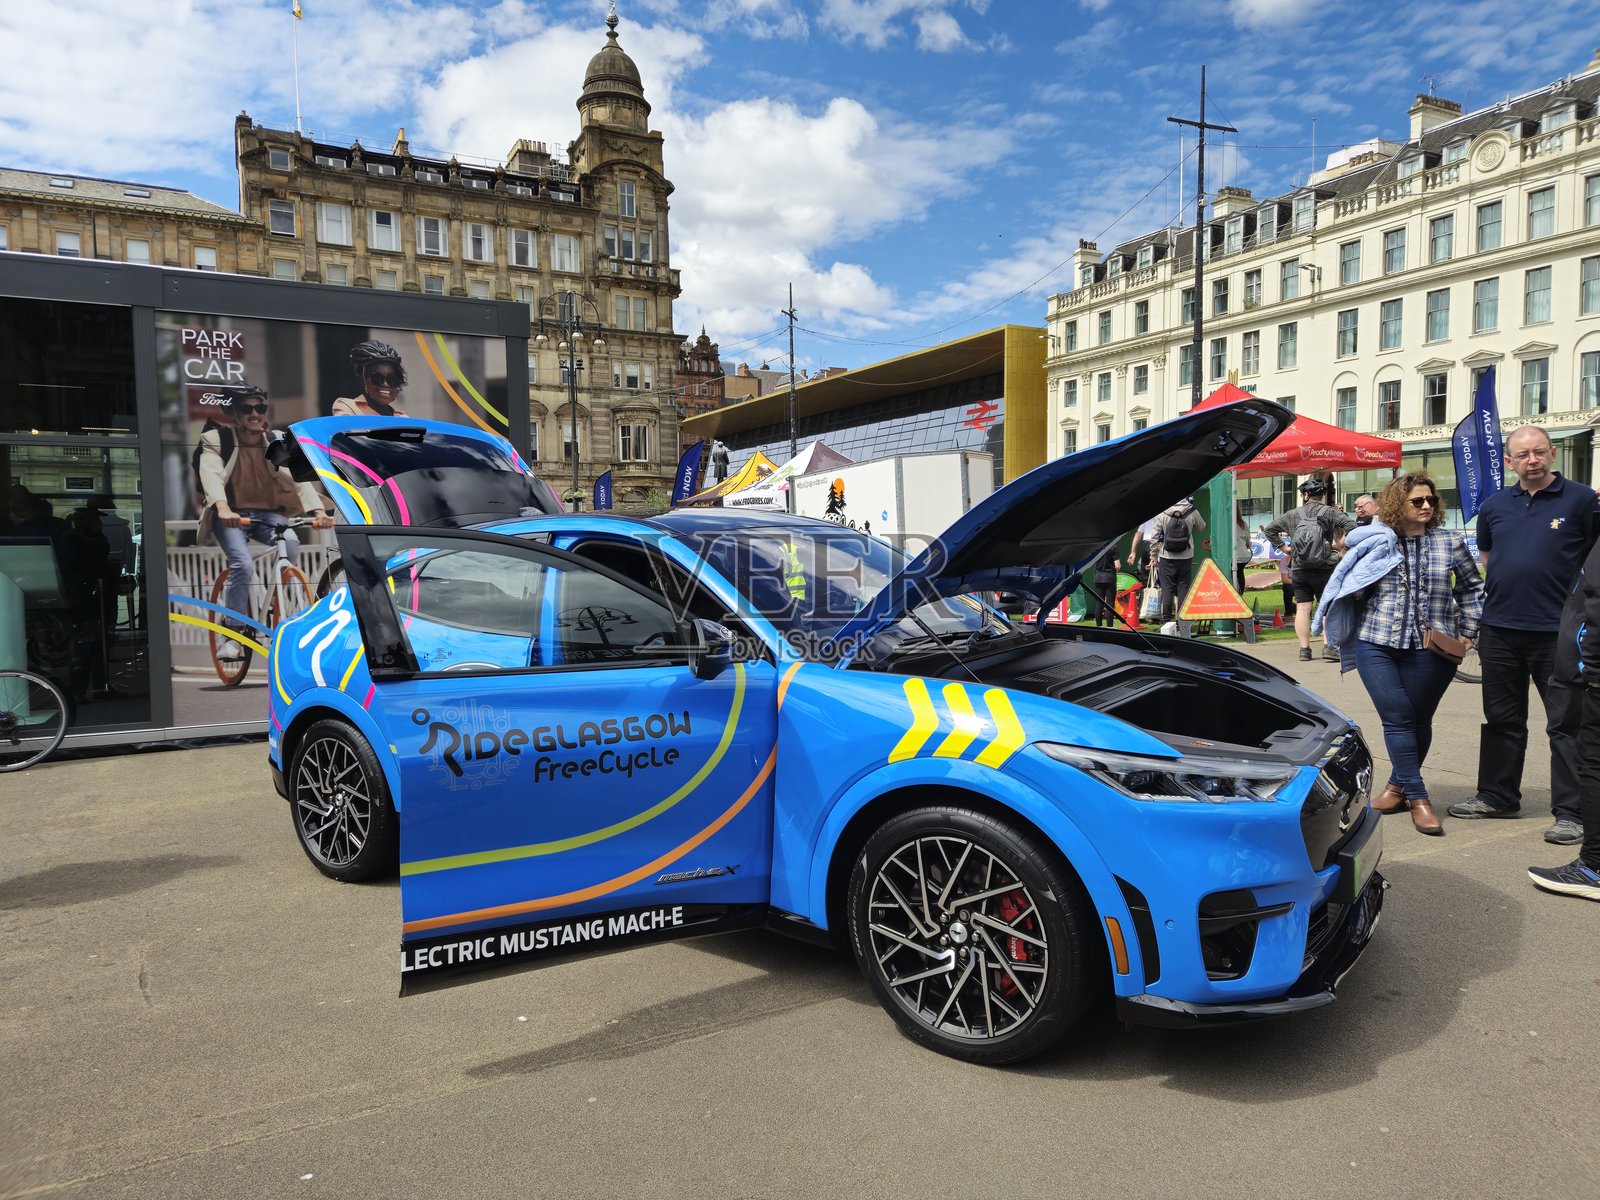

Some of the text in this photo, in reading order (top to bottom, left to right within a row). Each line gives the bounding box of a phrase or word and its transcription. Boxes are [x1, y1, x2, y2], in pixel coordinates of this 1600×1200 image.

[182, 328, 244, 349] PARK
[196, 346, 232, 360] THE
[184, 358, 245, 381] CAR
[199, 392, 233, 407] Ford
[1461, 435, 1473, 465] TODAY
[1482, 409, 1501, 490] stFord NOW
[683, 465, 693, 492] NOW
[1467, 466, 1477, 490] AWAY
[500, 918, 605, 956] MUSTANG
[608, 906, 684, 937] MACH-E
